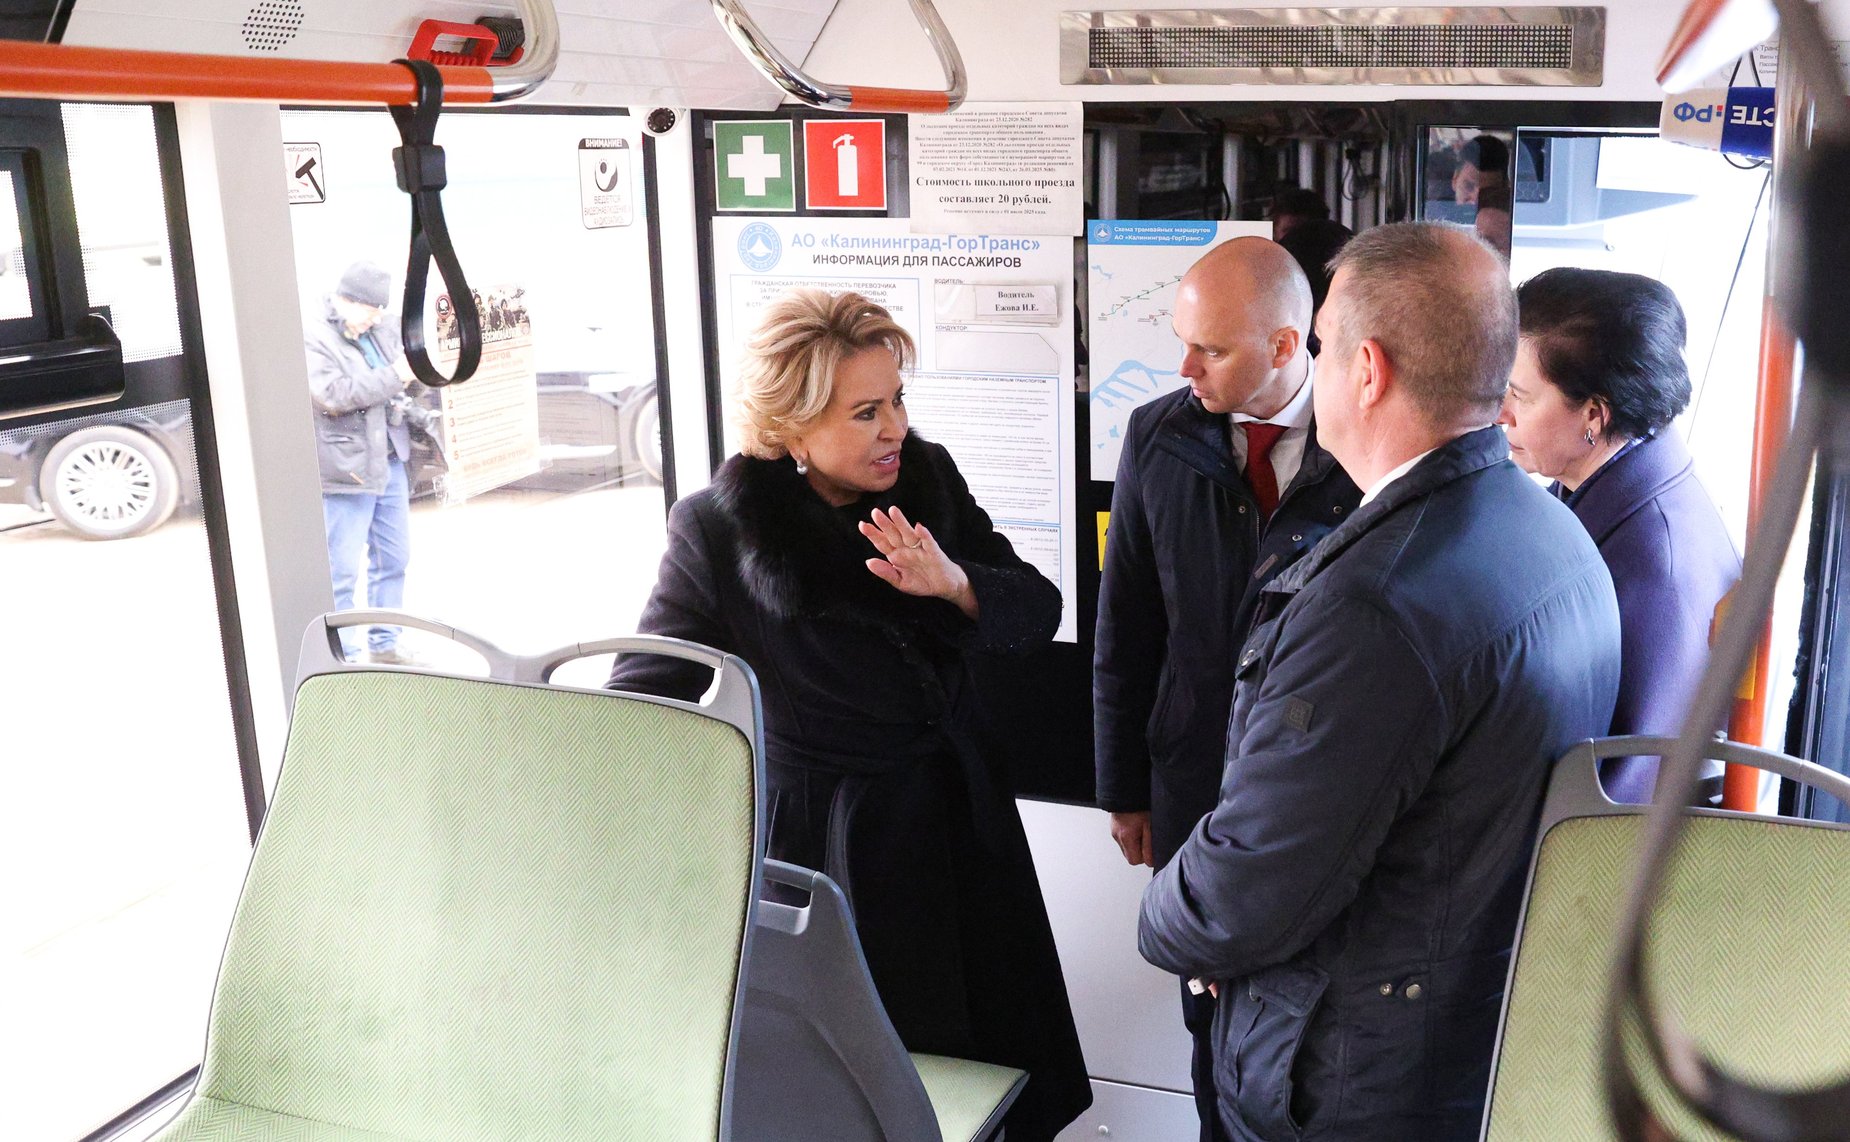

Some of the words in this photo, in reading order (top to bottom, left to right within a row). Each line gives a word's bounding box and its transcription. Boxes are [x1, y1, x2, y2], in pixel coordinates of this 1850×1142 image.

[1730, 105, 1775, 128] СТЕ
[585, 138, 622, 148] ВНИМАНИЕ!
[916, 176, 972, 186] Стоимость
[974, 178, 1032, 187] школьного
[1034, 179, 1075, 189] проезда
[939, 196, 994, 204] составляет
[998, 194, 1009, 203] 20
[1012, 194, 1051, 206] рублей.
[792, 233, 816, 248] АО
[821, 233, 1040, 253] «Калининград-ГорТранс»
[813, 254, 899, 267] ИНФОРМАЦИЯ
[903, 256, 928, 267] ДЛЯ
[932, 256, 1021, 267] ПАССАЖИРОВ
[448, 400, 454, 409] 2
[450, 418, 456, 427] 3
[451, 435, 457, 444] 4
[454, 451, 460, 460] 5
